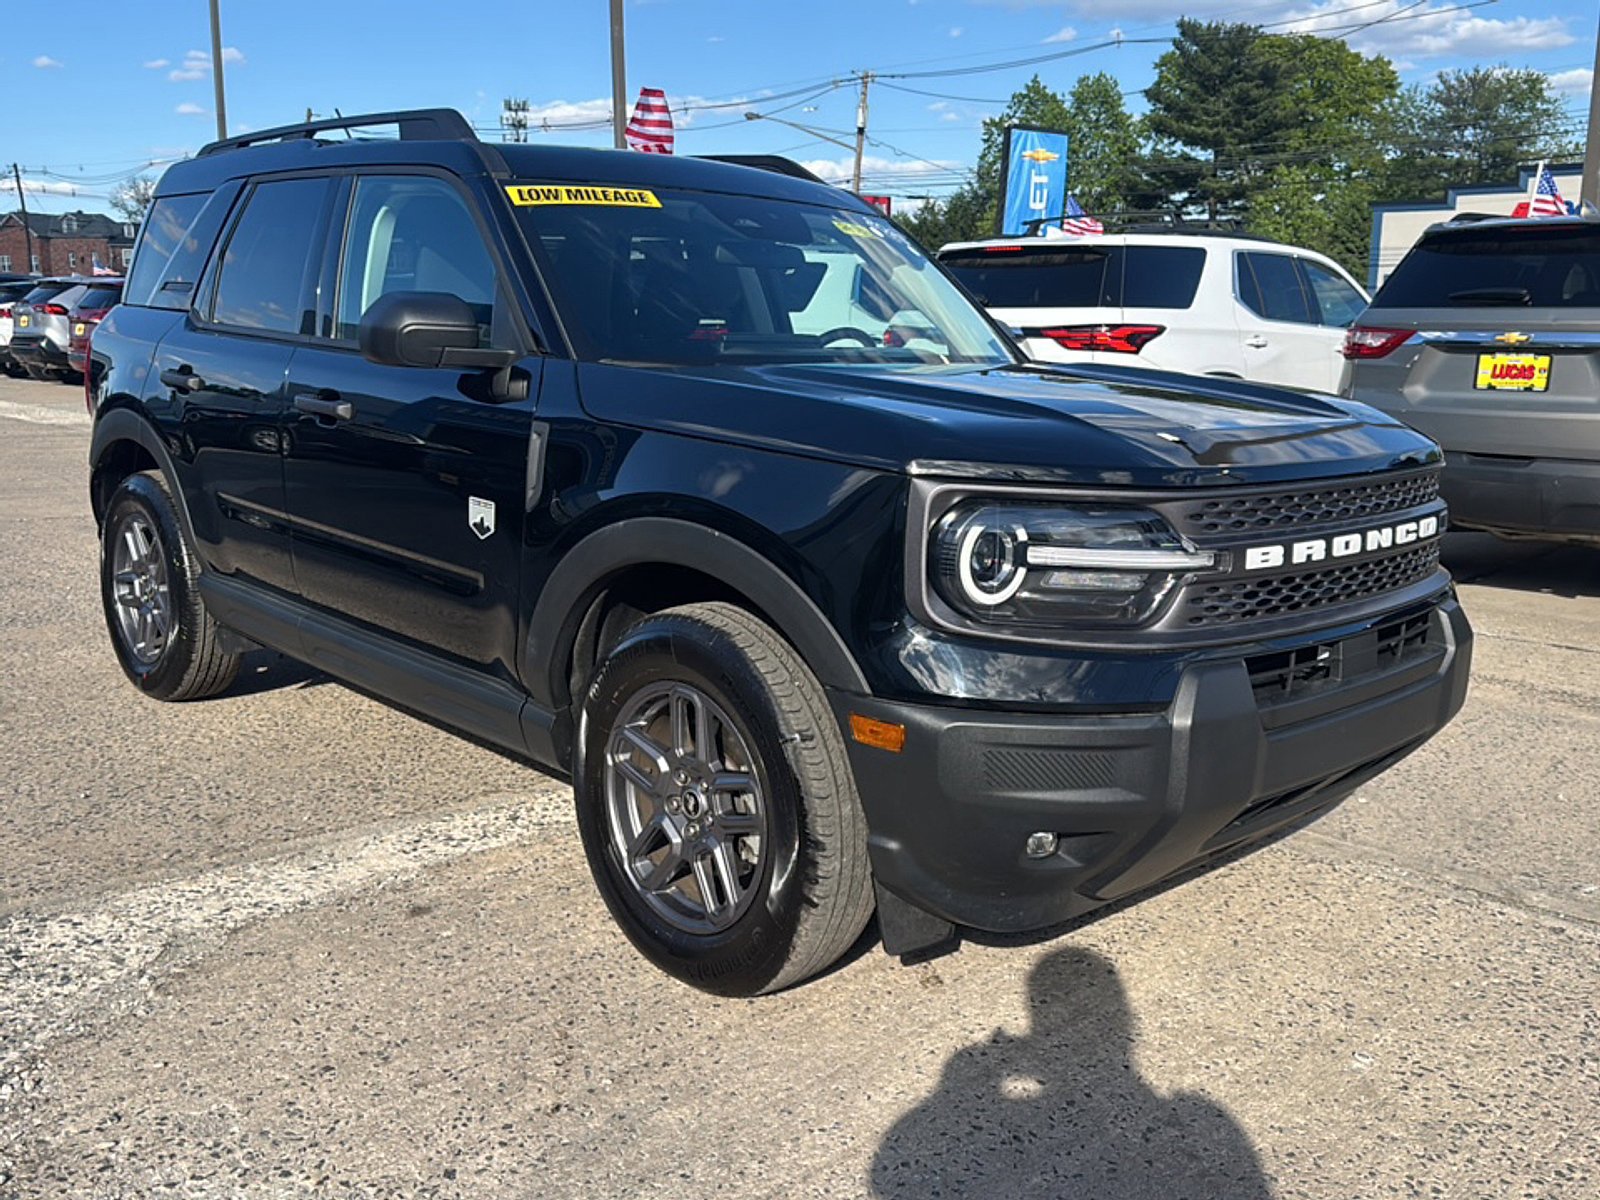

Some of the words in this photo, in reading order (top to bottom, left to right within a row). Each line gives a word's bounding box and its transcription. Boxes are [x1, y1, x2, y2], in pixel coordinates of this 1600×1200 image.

[517, 188, 563, 202] LOW
[565, 188, 651, 203] MILEAGE
[1491, 364, 1535, 380] LUCAS
[1245, 516, 1438, 570] BRONCO
